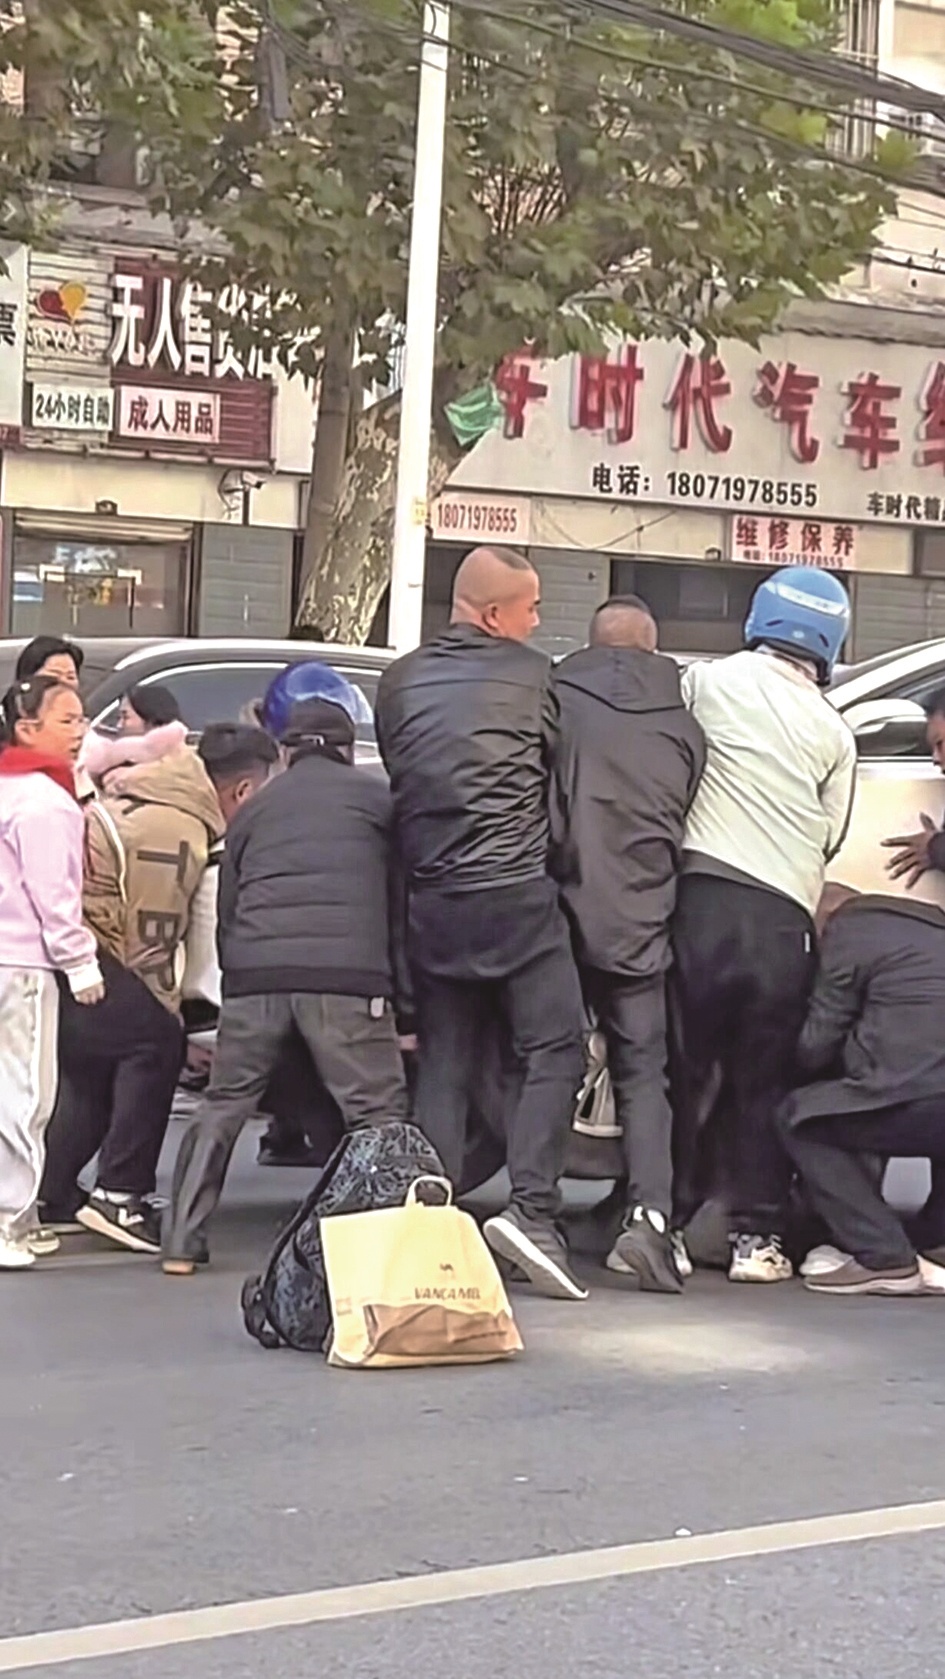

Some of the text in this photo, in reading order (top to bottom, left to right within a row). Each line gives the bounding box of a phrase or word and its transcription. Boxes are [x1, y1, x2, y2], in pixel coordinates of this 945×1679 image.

[128, 396, 214, 435] 成人用品
[667, 471, 818, 507] 18071978555
[437, 502, 517, 533] 18071978555
[735, 517, 854, 556] 维修保养
